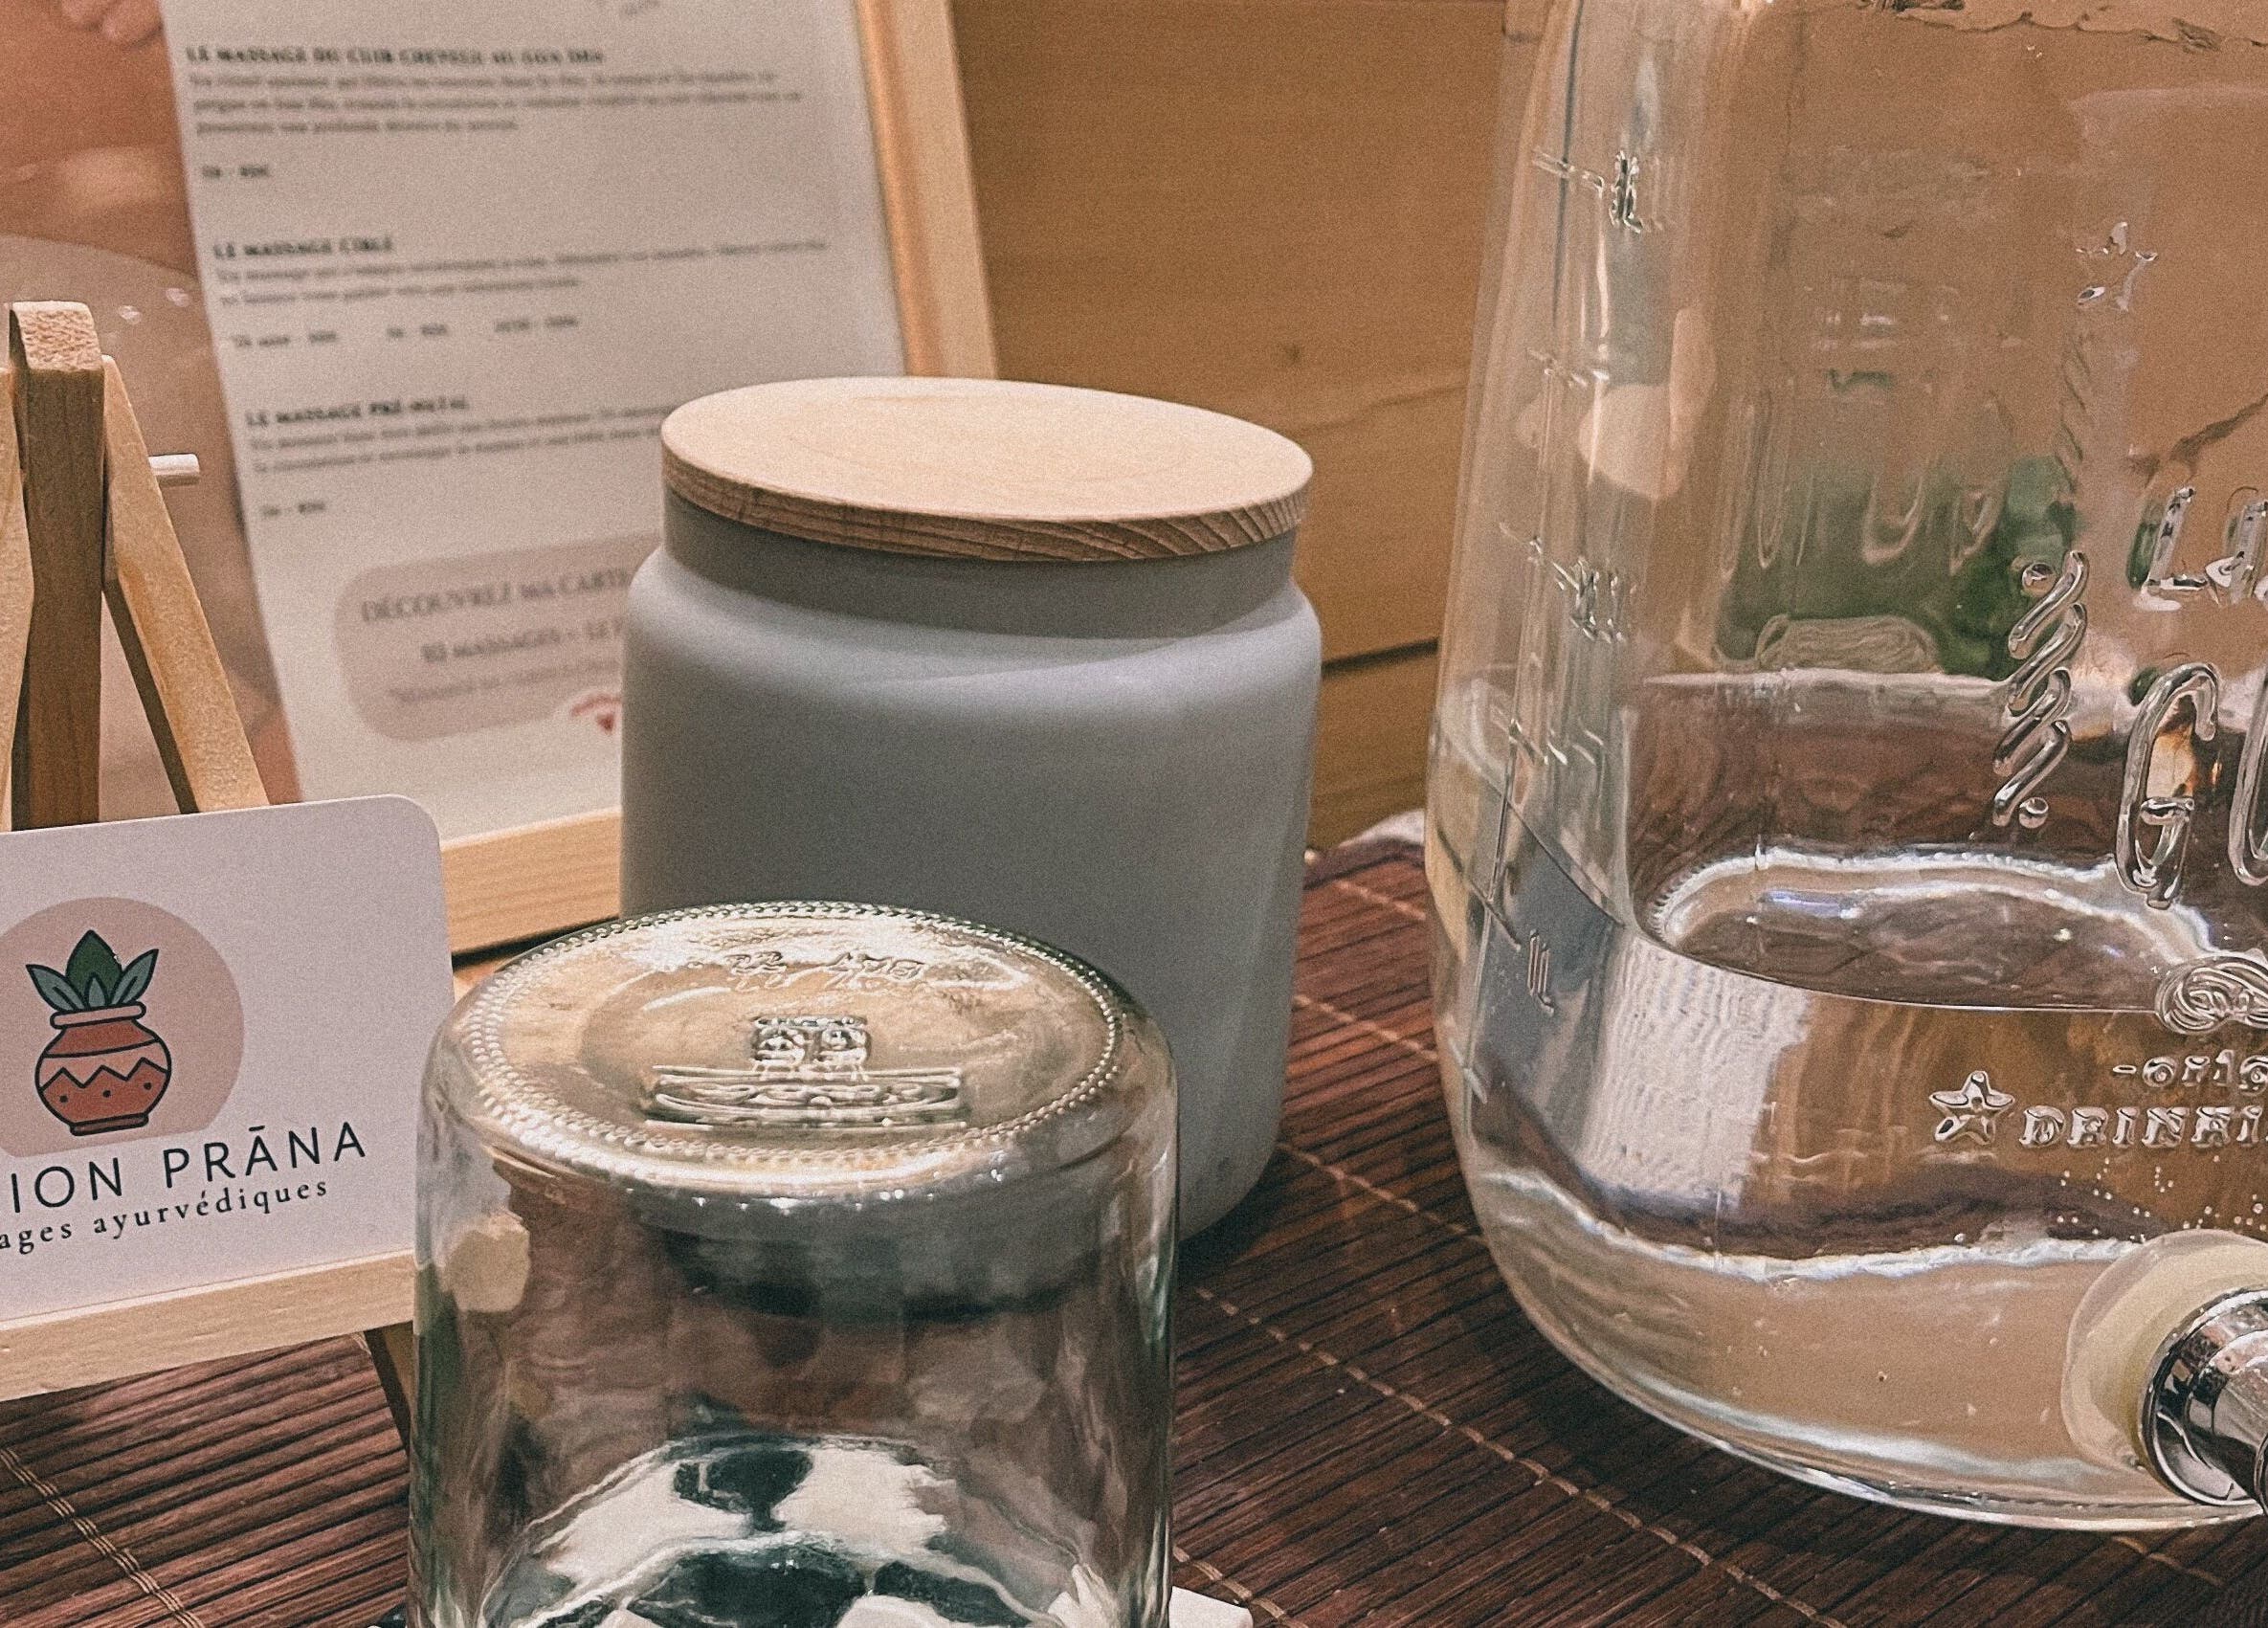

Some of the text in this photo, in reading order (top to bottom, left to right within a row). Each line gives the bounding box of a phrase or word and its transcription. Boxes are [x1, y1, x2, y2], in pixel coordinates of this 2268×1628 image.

[11, 1121, 367, 1214] ION PRĀNA
[93, 1181, 328, 1239] ayurvédiques
